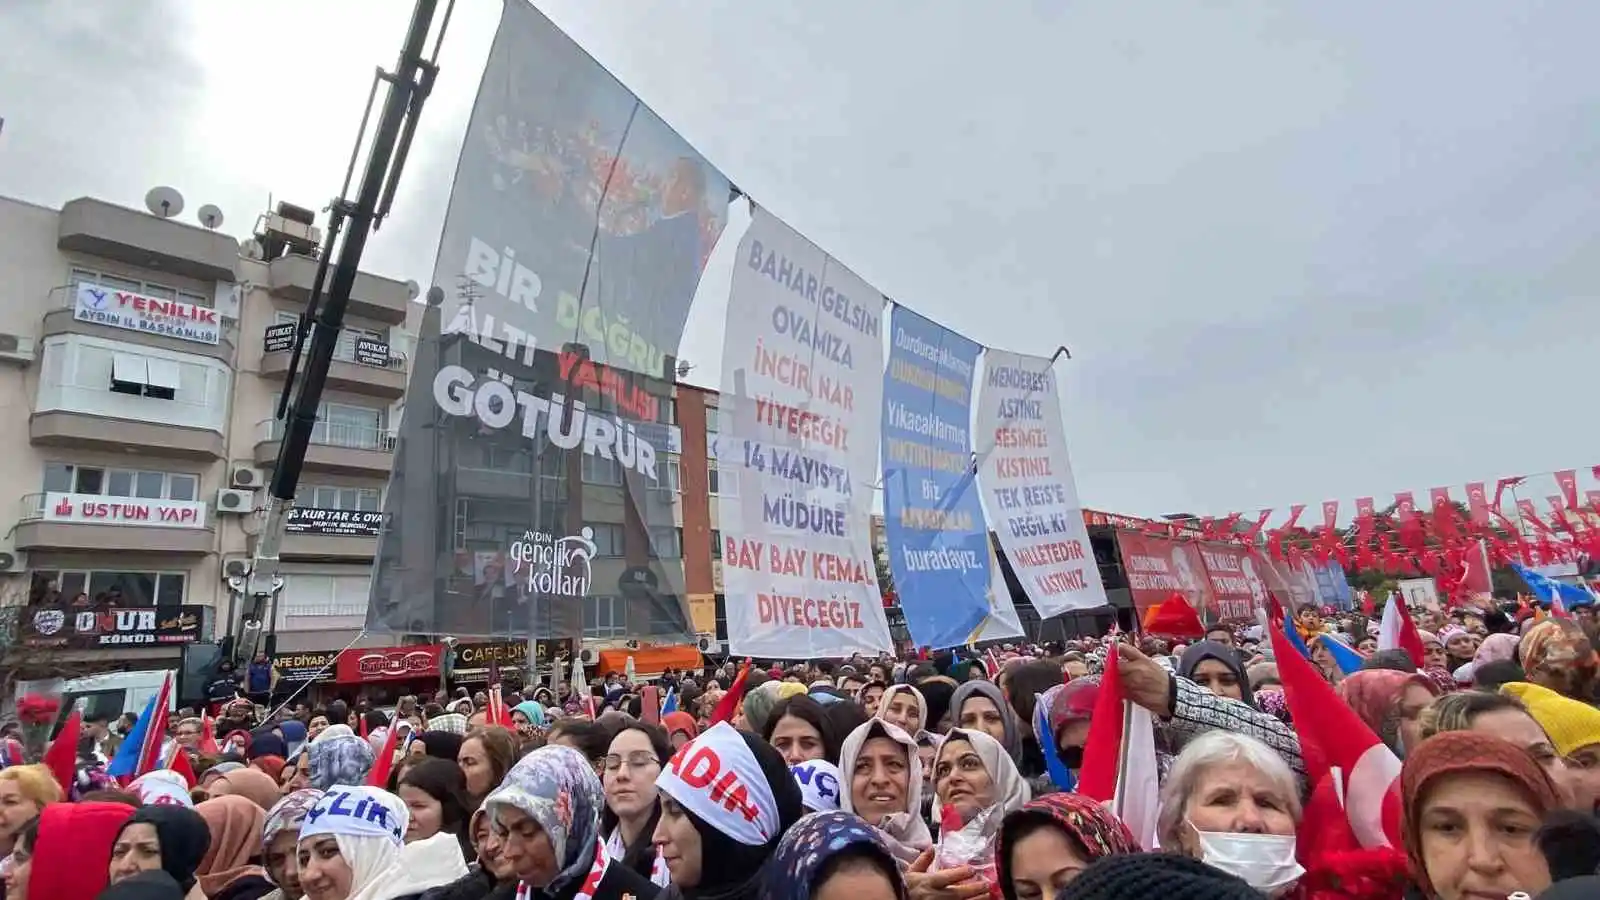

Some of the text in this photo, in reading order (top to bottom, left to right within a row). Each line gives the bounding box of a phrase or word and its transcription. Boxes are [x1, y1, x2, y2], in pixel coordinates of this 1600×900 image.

[464, 236, 543, 313] BİR
[749, 240, 878, 338] BAHAR GELSİN
[79, 310, 121, 324] AYDIN
[116, 292, 217, 324] YENİLİK
[358, 341, 388, 353] AVUKAT
[448, 304, 539, 367] ALTI
[556, 290, 666, 379] DOĞRU
[772, 305, 853, 370] OVAMIZA
[819, 375, 854, 411] NAR
[433, 365, 658, 481] GÖTÜRÜR
[756, 394, 849, 451] YİYECEĞİZ
[744, 440, 766, 472] 14
[772, 447, 853, 497] MAYIS'TA
[922, 479, 941, 500] Biz
[994, 487, 1021, 509] TEK
[82, 501, 198, 523] ÜSTÜN YAPI
[301, 509, 384, 523] KURTAR & OYA
[763, 494, 846, 537] MÜDÜRE
[1008, 512, 1050, 538] DEĞİL
[1053, 513, 1067, 533] Kİ
[523, 531, 552, 543] AYDIN
[510, 539, 572, 574] gençlik
[726, 536, 874, 587] BAY BAY KEMAL
[903, 543, 984, 575] buradayız.
[528, 563, 586, 597] kolları
[75, 609, 156, 633] ONUR
[757, 587, 864, 629] DİYECEĞİZ
[273, 654, 325, 668] AFE DİYAR
[462, 644, 547, 662] CAFE DİYR
